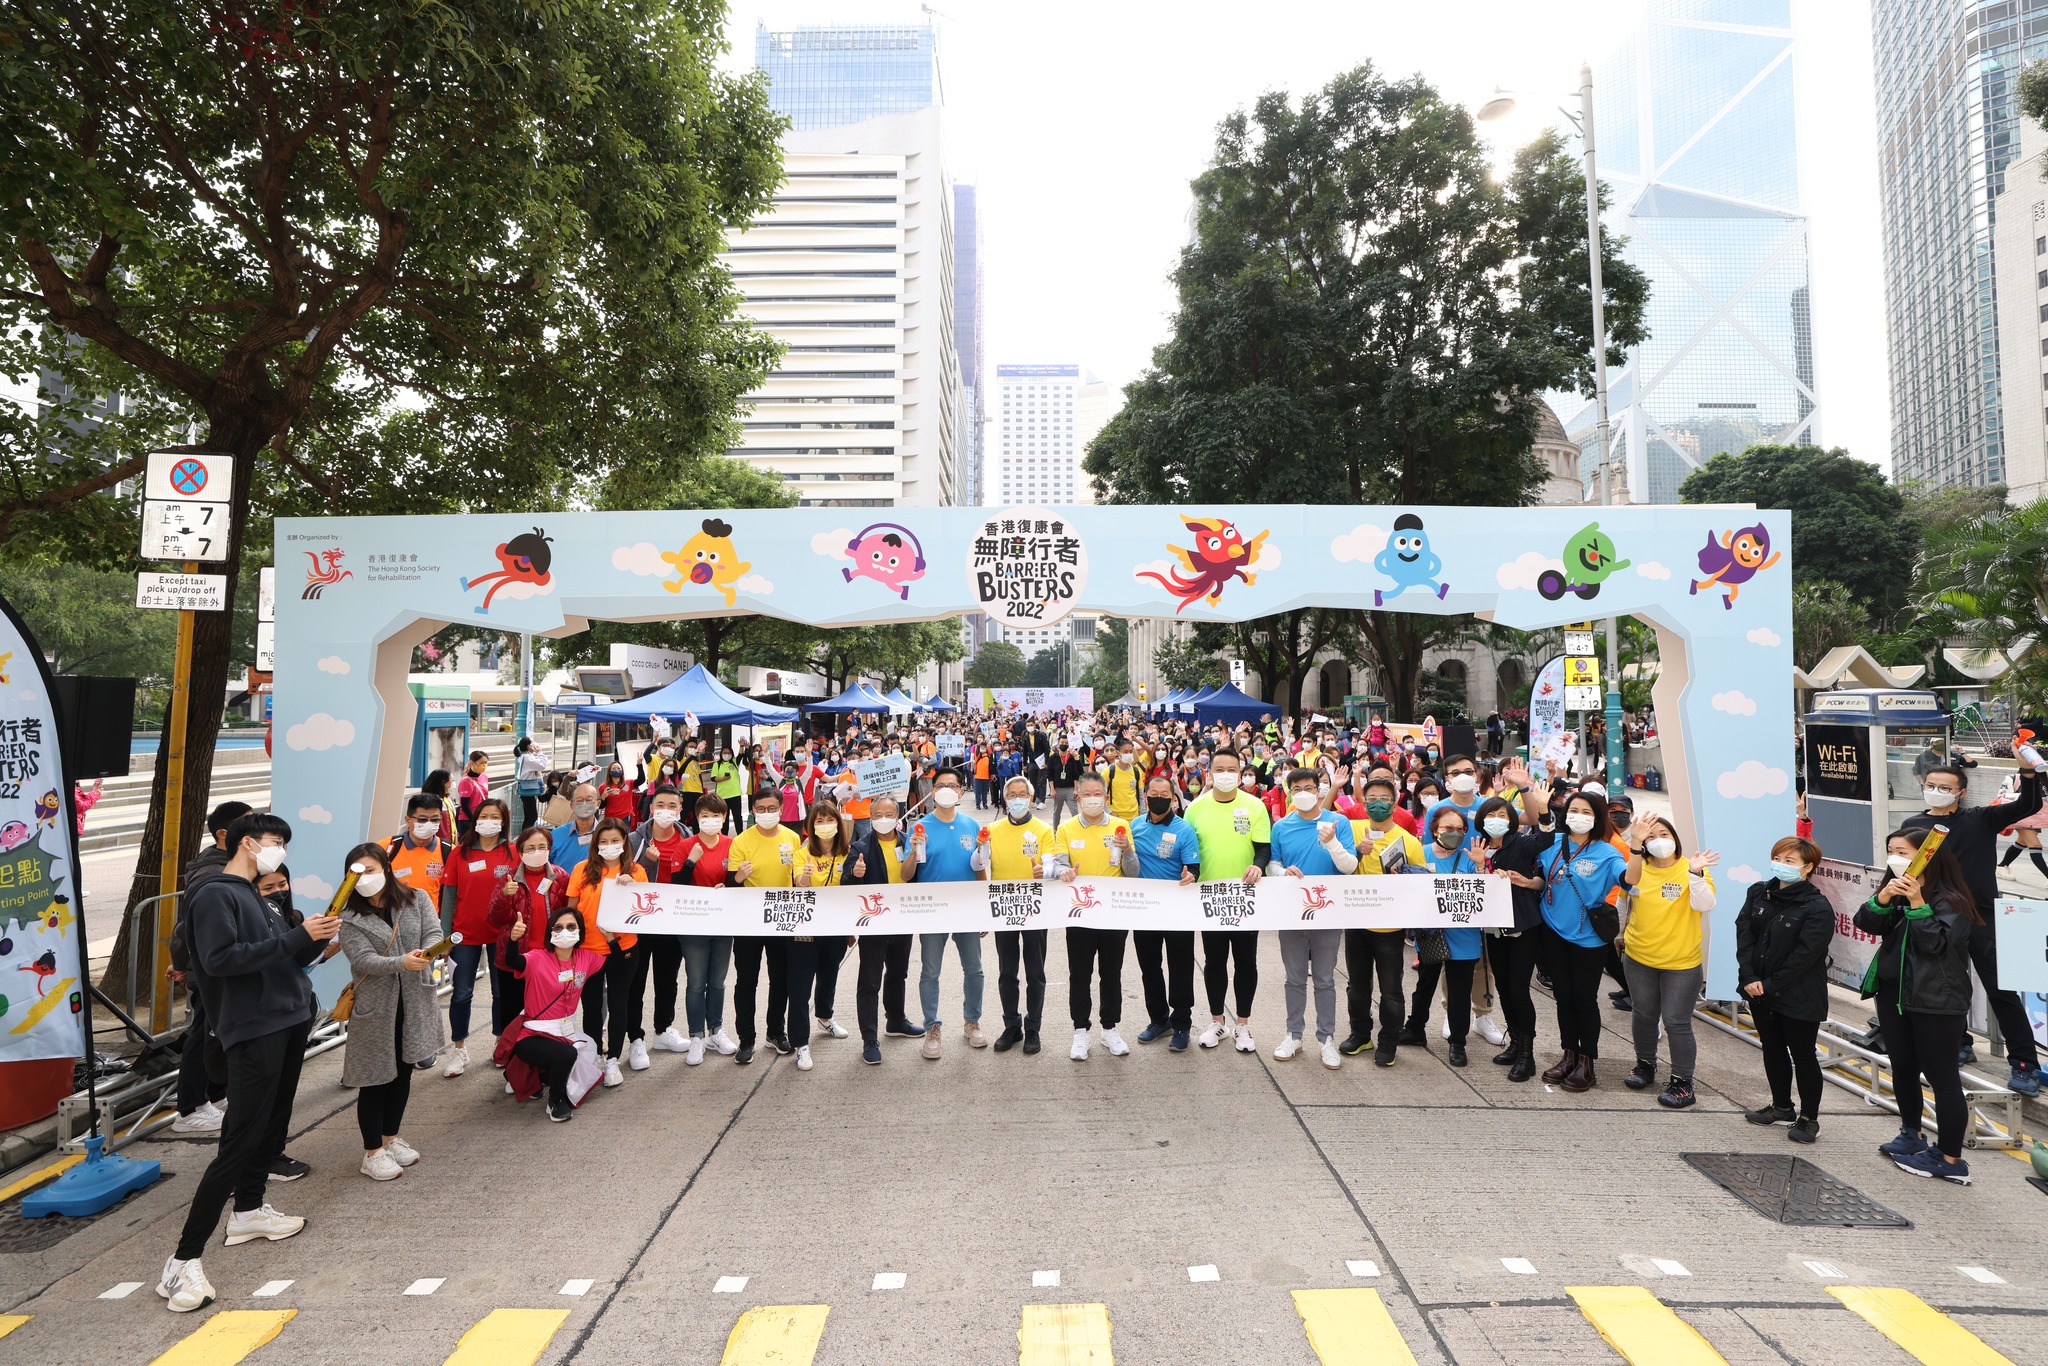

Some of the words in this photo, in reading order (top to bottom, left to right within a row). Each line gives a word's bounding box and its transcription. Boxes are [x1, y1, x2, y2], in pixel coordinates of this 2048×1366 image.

[165, 504, 181, 512] am
[160, 514, 185, 525] 上午
[200, 507, 214, 525] 7
[985, 519, 1064, 536] 香港復康會
[163, 534, 180, 543] pm
[160, 545, 184, 556] 下午
[198, 538, 212, 556] 7
[974, 536, 1080, 568] 無障行者
[368, 553, 418, 563] 香港復康會
[381, 565, 398, 573] Hong
[400, 565, 417, 573] Kong
[418, 564, 441, 573] Society
[995, 562, 1058, 579] BARRIER
[159, 576, 190, 585] Except
[190, 577, 207, 585] taxi
[147, 585, 166, 593] pick
[167, 586, 202, 595] up/drop
[977, 571, 1075, 603] BUSTERS
[141, 596, 219, 608] 的士上落客除外
[1007, 601, 1045, 619] 2022
[631, 660, 645, 668] COCO
[645, 661, 660, 669] CRUSH
[1589, 700, 1599, 708] 12
[1817, 744, 1857, 762] Wi-Fi
[1821, 772, 1845, 780] Available
[0, 783, 20, 799] 22
[988, 882, 1043, 899] 無障行者
[1200, 882, 1256, 899] 無障行者
[1434, 878, 1486, 895] 無障行者
[27, 887, 49, 901] Point
[764, 890, 816, 907] 無障行者
[1445, 892, 1475, 901] BARRIER
[1000, 895, 1032, 906] BARRIER
[1212, 896, 1246, 906] BARRIER
[1437, 897, 1484, 915] BUSTERS
[773, 903, 806, 912] BARRIER
[990, 900, 1042, 918] BUSTERS
[1203, 900, 1255, 918] BUSTERS
[764, 908, 814, 923] BUSTERS
[1006, 916, 1026, 926] 2022
[1452, 913, 1470, 924] 2022
[776, 922, 796, 932] 2022
[1220, 917, 1240, 926] 2022
